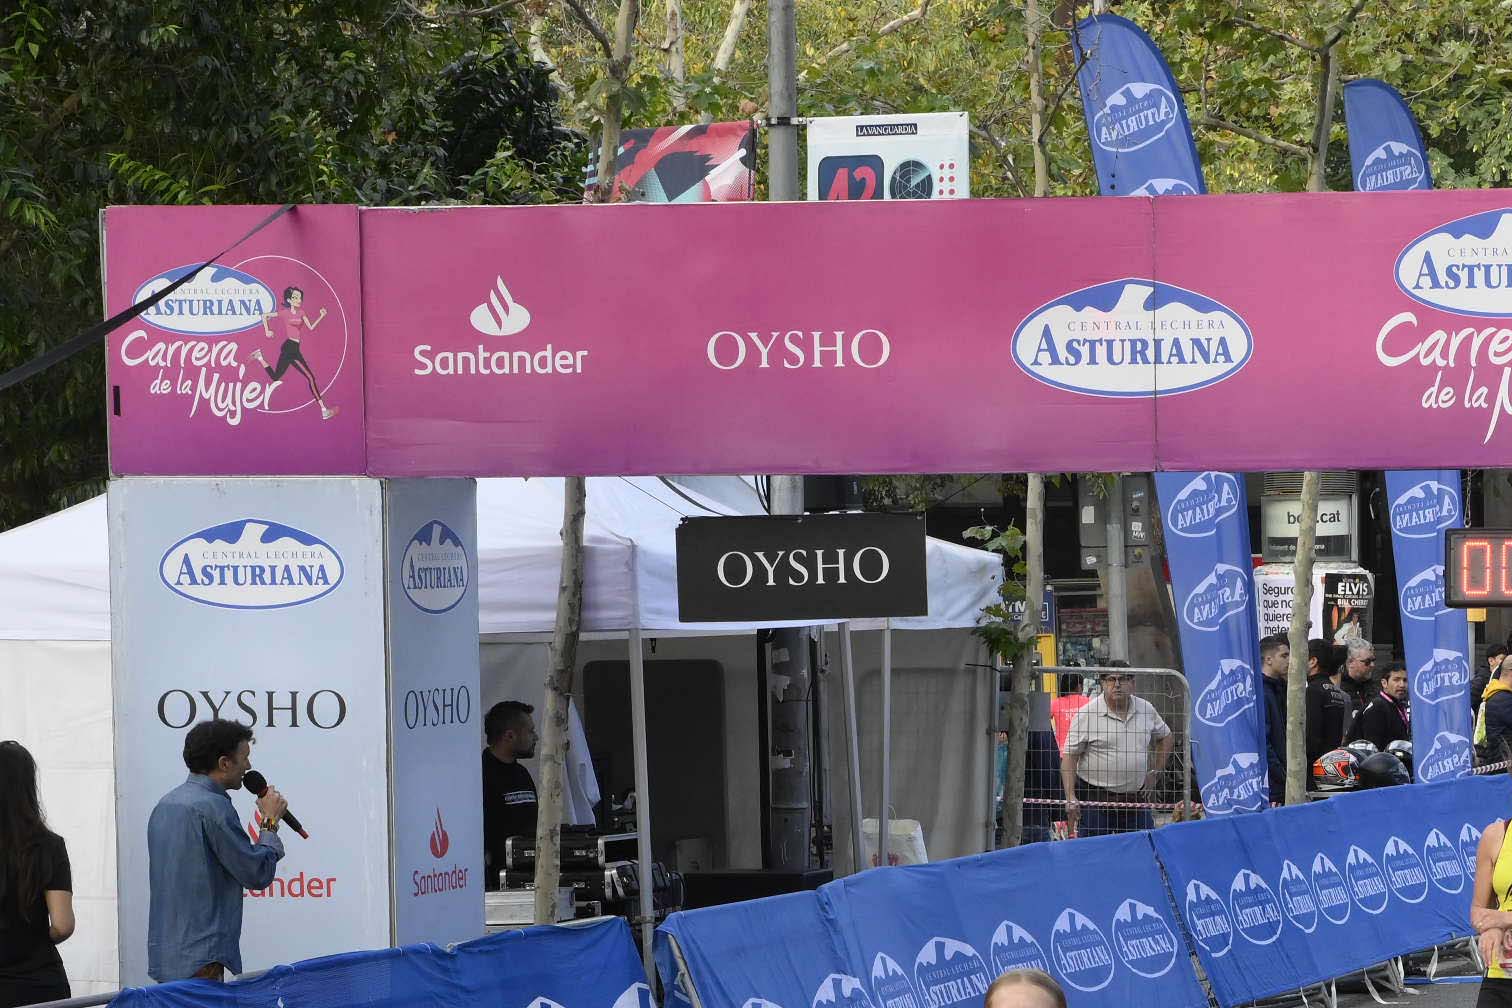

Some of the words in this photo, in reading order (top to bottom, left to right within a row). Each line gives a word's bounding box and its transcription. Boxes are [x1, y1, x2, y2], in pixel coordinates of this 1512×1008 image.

[143, 290, 264, 316] ASTURIANA
[1067, 320, 1143, 332] CENTRAL
[1150, 319, 1226, 331] LECHERA
[120, 329, 240, 368] Carrera
[413, 344, 589, 375] Santander
[706, 329, 892, 370] OYSHO
[1029, 323, 1235, 367] ASTURIANA
[150, 368, 173, 395] de
[176, 367, 193, 395] la
[189, 365, 284, 426] Mujer
[1421, 370, 1456, 409] de
[1464, 367, 1489, 409] la
[174, 552, 331, 586] ASTURIANA
[202, 551, 260, 560] CENTRAL
[265, 550, 325, 559] LECHERA
[406, 555, 465, 590] ASTURIANA
[717, 546, 891, 588] OYSHO
[1337, 582, 1369, 595] ELVIS
[157, 688, 347, 729] OYSHO
[404, 685, 471, 730] OYSHO
[412, 863, 469, 898] Santander
